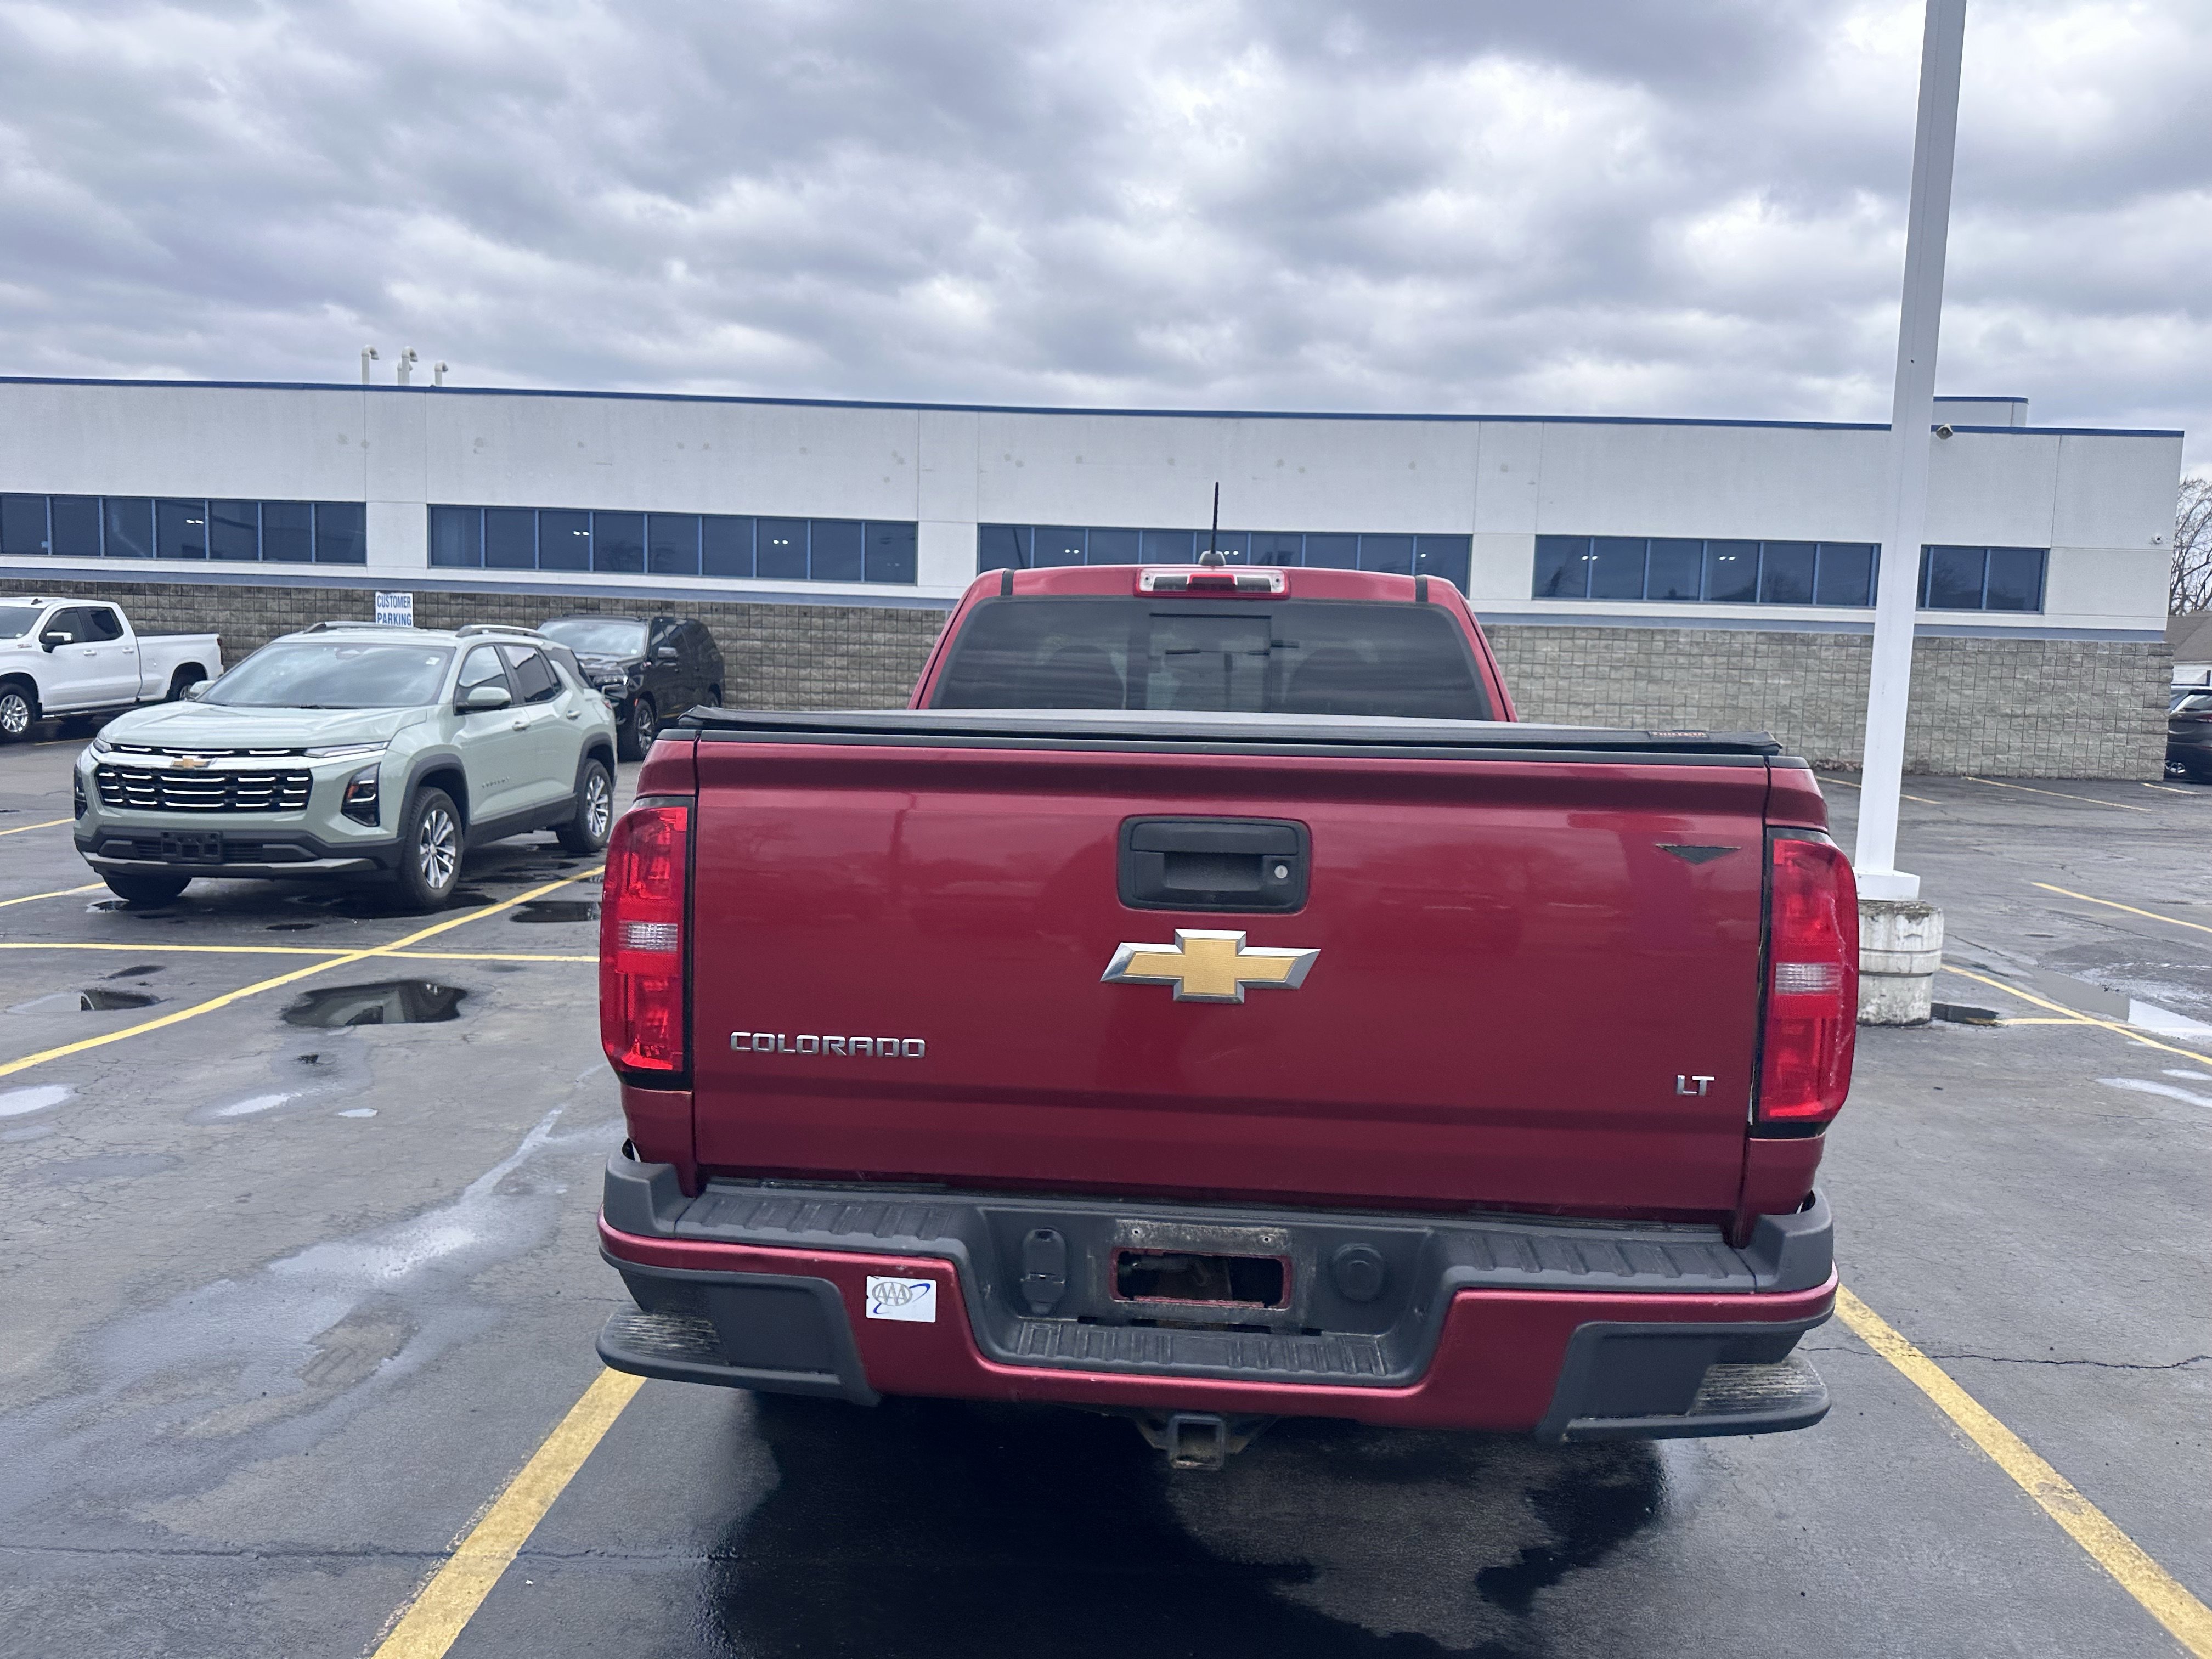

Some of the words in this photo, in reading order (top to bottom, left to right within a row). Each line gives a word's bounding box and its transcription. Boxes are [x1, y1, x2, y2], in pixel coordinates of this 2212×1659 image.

[377, 595, 411, 608] CUSTOMER
[377, 612, 412, 625] PARKING
[730, 1031, 925, 1058] COLORADO
[1677, 1075, 1715, 1096] LT
[875, 1282, 911, 1306] AAA
